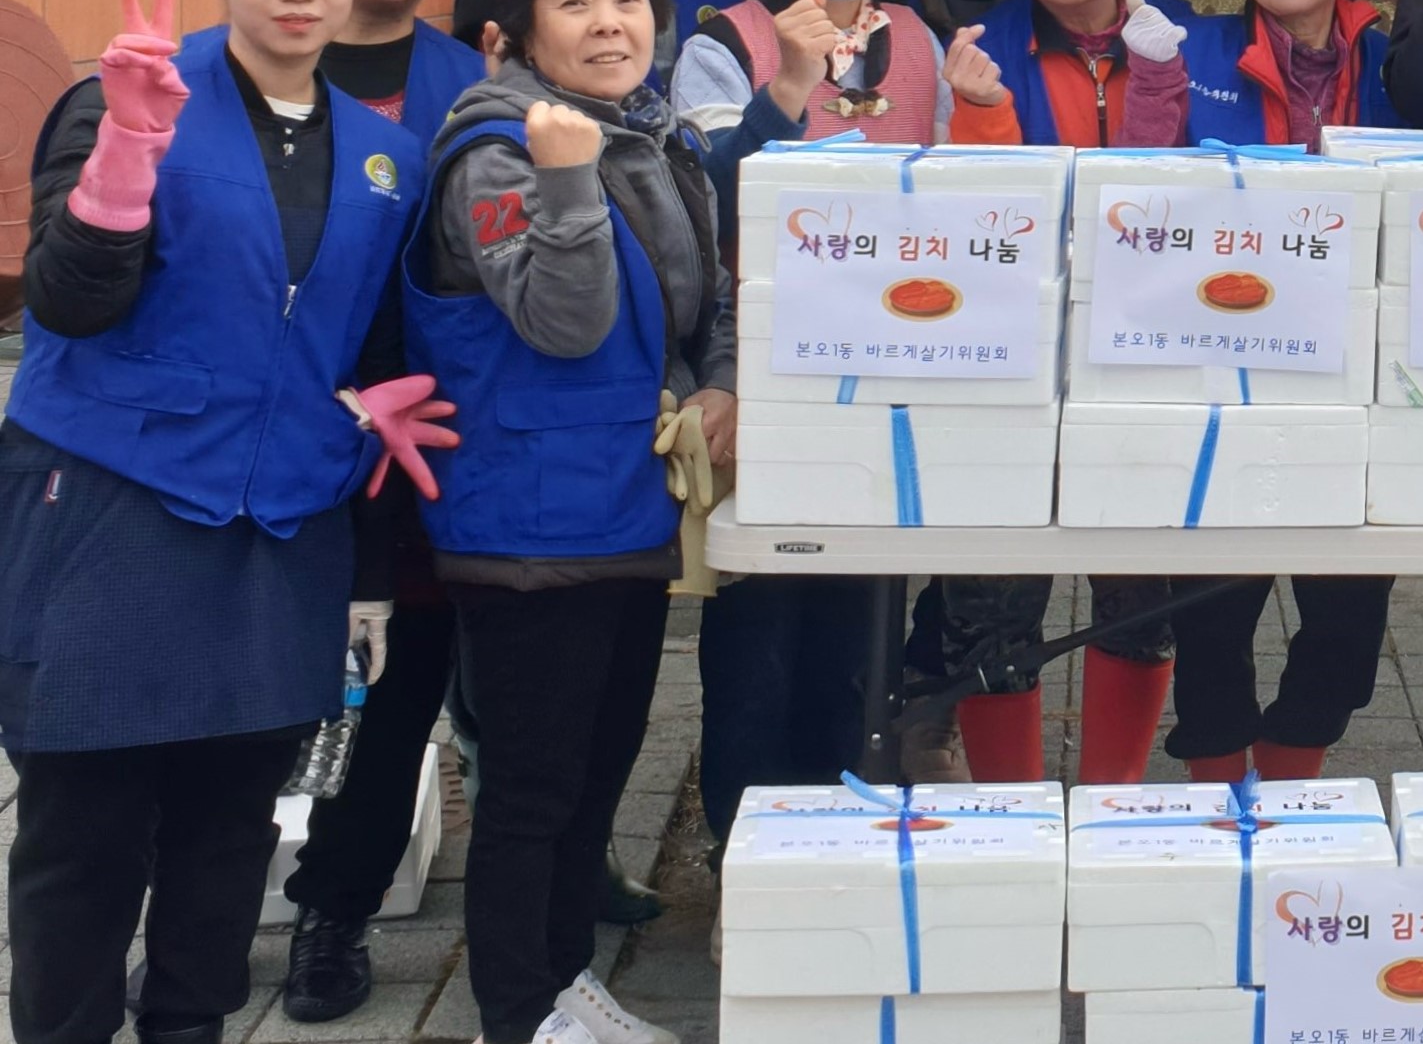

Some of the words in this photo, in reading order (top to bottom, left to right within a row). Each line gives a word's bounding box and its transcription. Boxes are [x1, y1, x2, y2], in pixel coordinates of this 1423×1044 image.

[471, 191, 530, 245] 22
[796, 233, 876, 260] 사랑의
[900, 236, 947, 261] 김치
[970, 239, 1019, 263] 나눔
[1115, 226, 1193, 252] 사랑의
[1215, 230, 1261, 254] 김치
[1283, 229, 1329, 259] 나눔
[797, 343, 853, 359] 본오1동
[867, 345, 1007, 362] 바르게살기위원회
[1114, 333, 1168, 349] 본오1동
[1182, 335, 1316, 355] 바르게살기위원회
[1283, 801, 1332, 811] 나눔
[1286, 913, 1369, 943] 사랑의
[1290, 1029, 1349, 1044] 본오1동
